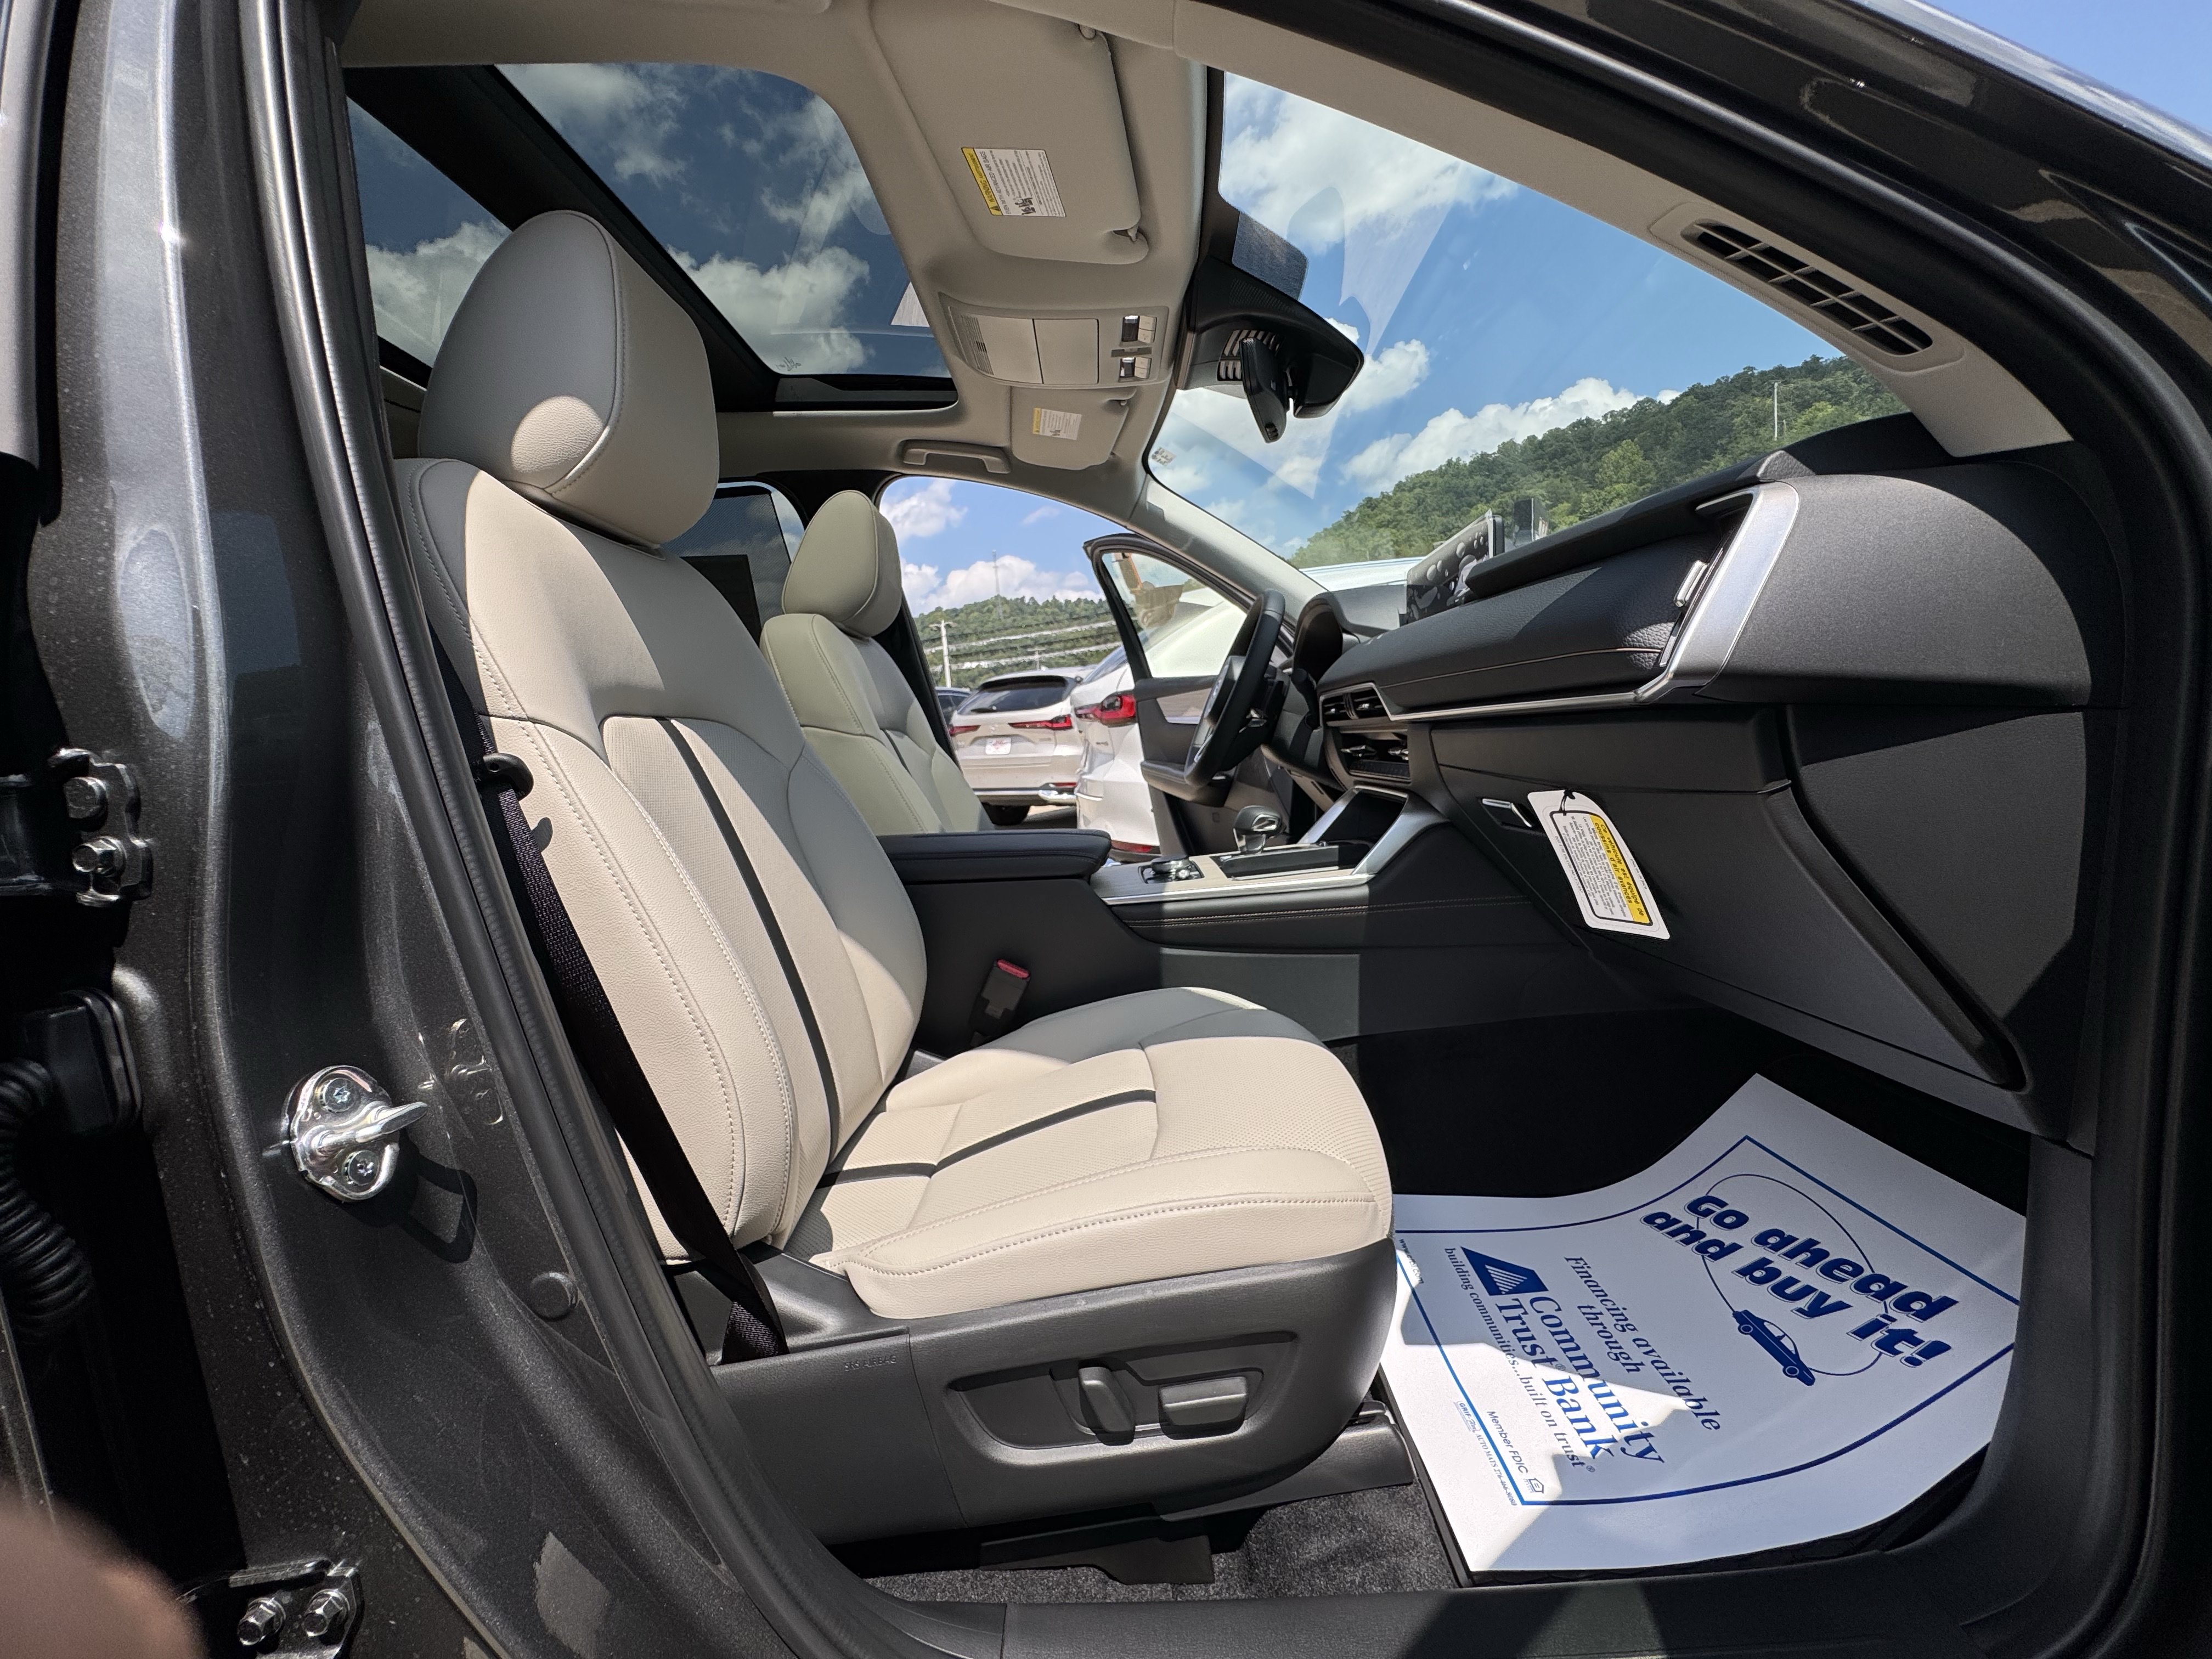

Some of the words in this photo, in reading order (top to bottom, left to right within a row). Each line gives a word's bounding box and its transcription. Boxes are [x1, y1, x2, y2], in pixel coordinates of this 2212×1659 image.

[1640, 1211, 1744, 1262] and
[1732, 1256, 1853, 1319] buy
[1846, 1313, 1952, 1368] it!
[1684, 1195, 1750, 1232] Go
[1751, 1228, 1959, 1323] ahead
[1444, 1248, 1474, 1290] building
[1540, 1410, 1558, 1428] on
[1529, 1296, 1665, 1464] Community
[1564, 1256, 1639, 1333] Financing
[1632, 1338, 1721, 1431] available
[1577, 1304, 1646, 1374] through
[1476, 1433, 1489, 1450] AUTO
[1485, 1451, 1498, 1468] MATS
[1487, 1410, 1514, 1448] Member
[1509, 1451, 1528, 1474] FDIC
[1542, 1375, 1618, 1459] Bank
